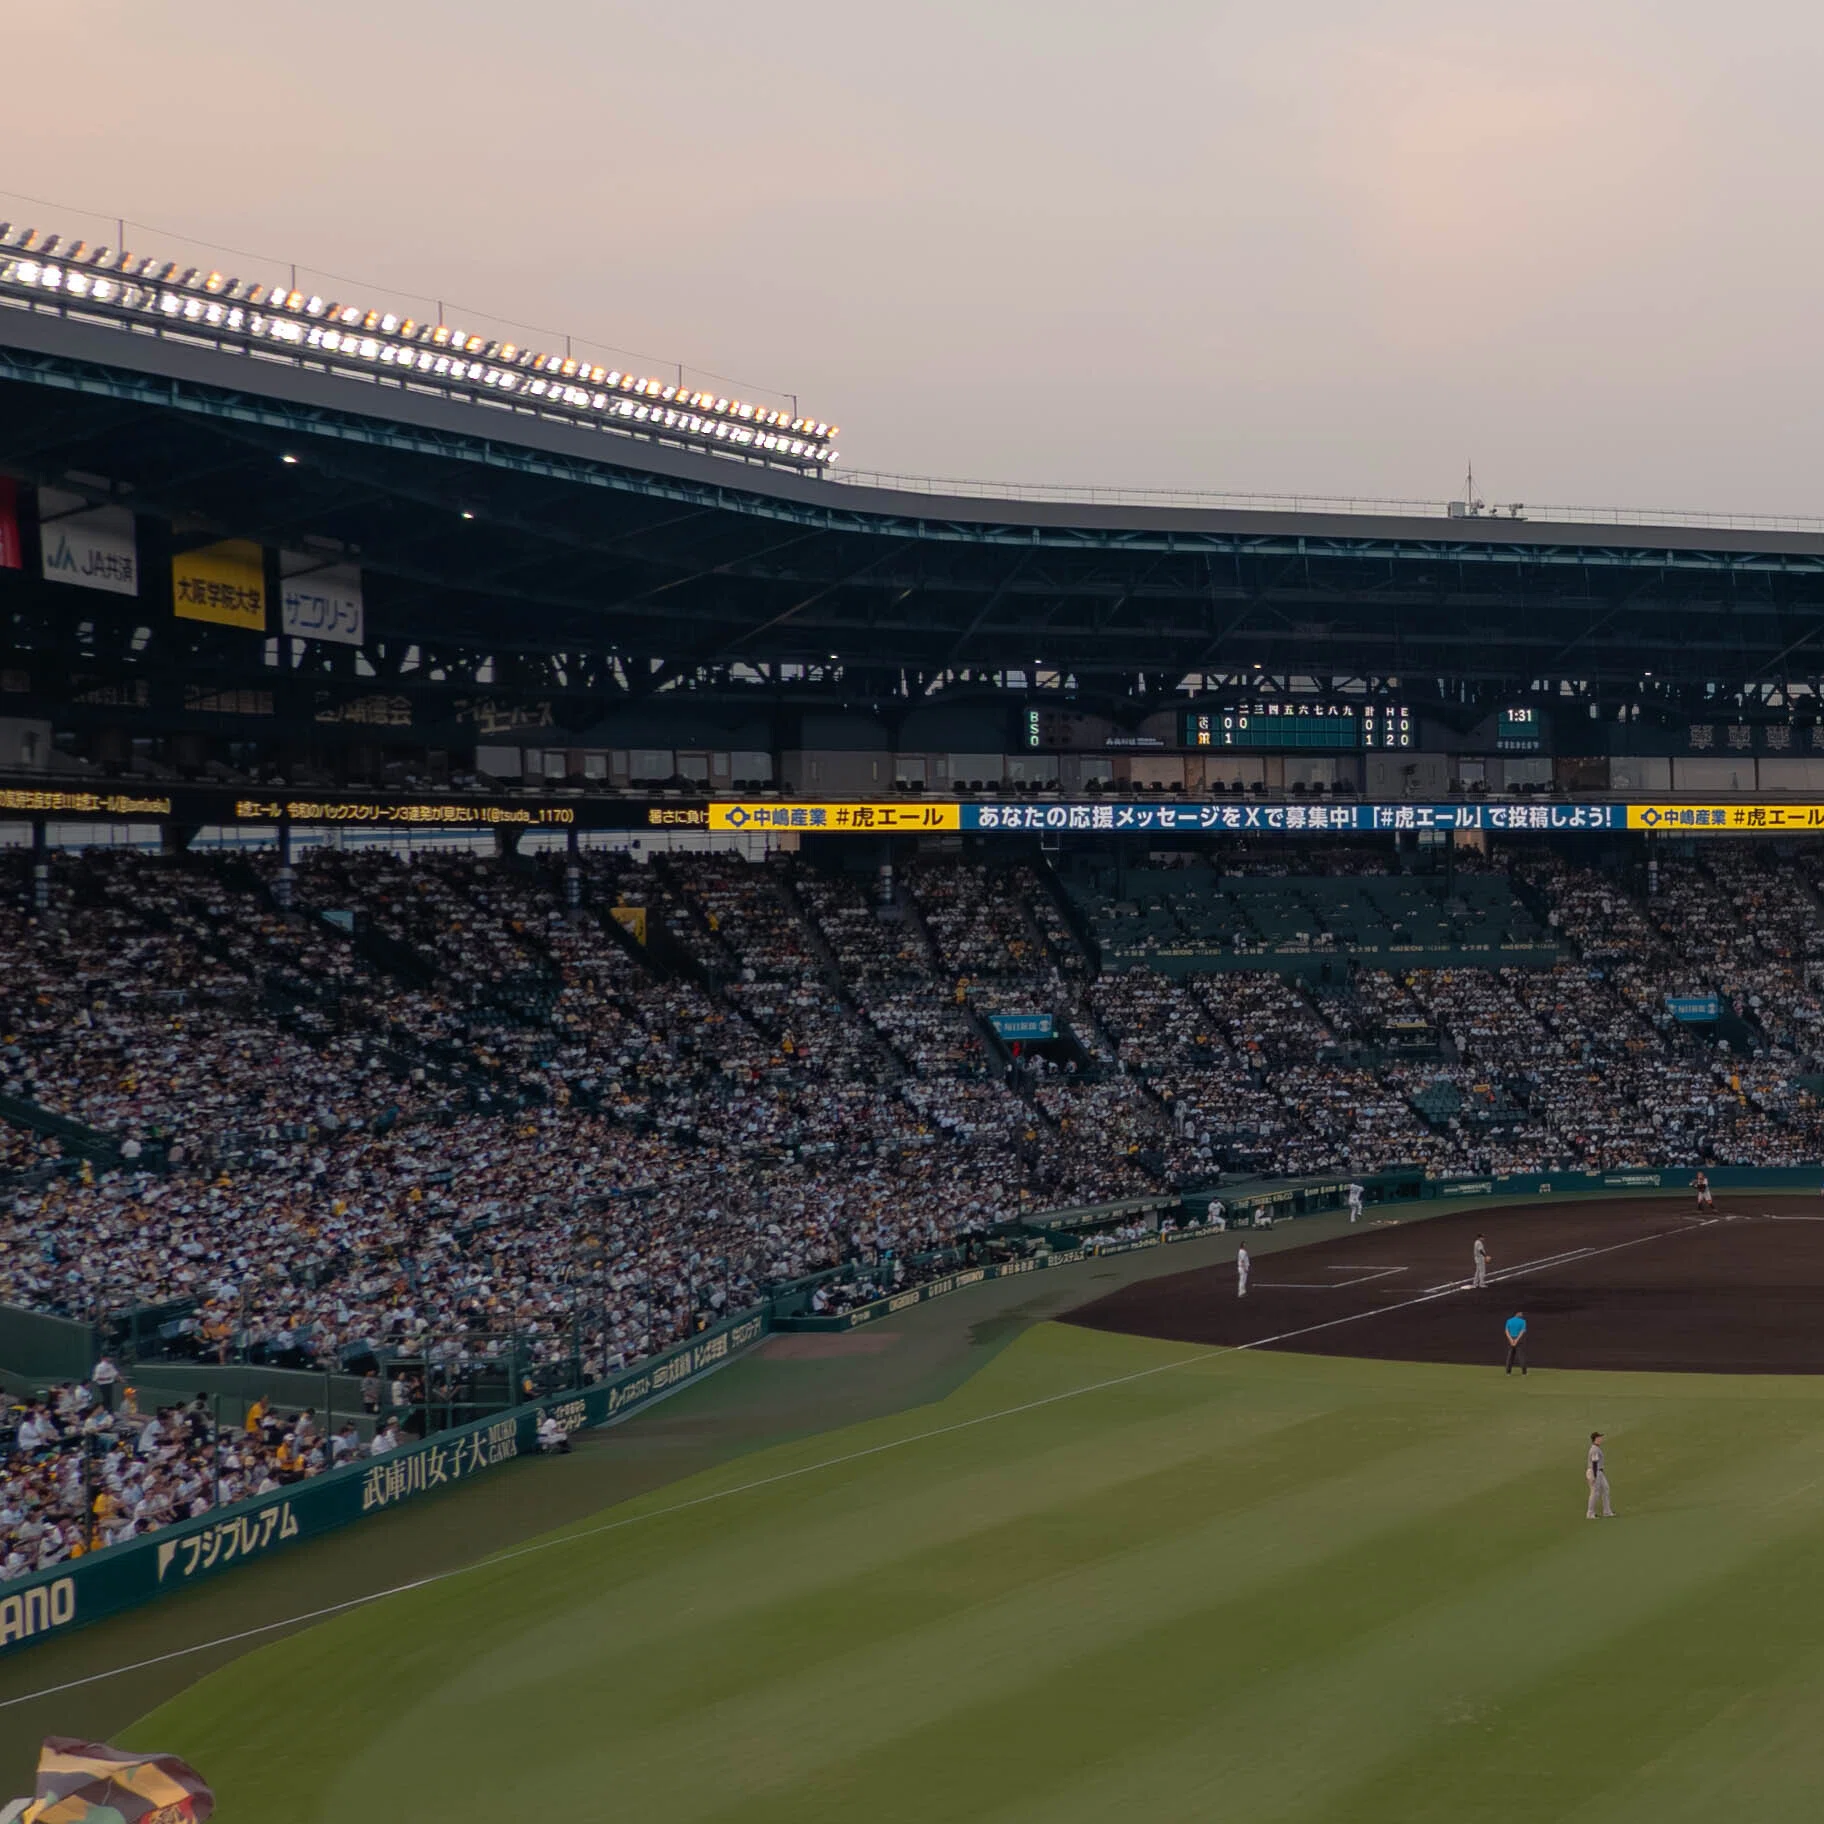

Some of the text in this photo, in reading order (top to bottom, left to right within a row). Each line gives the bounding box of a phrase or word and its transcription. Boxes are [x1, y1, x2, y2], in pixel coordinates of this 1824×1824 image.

[176, 577, 262, 615] 大阪学院大学
[1029, 711, 1039, 723] B
[1507, 708, 1533, 722] 1:31
[1029, 723, 1039, 735] S
[753, 806, 945, 829] 中嶋産業 #虎エール
[1663, 808, 1727, 827] 中嶋産業
[362, 1429, 488, 1512] 武庫川女子大
[181, 1500, 300, 1577] フジプレアム
